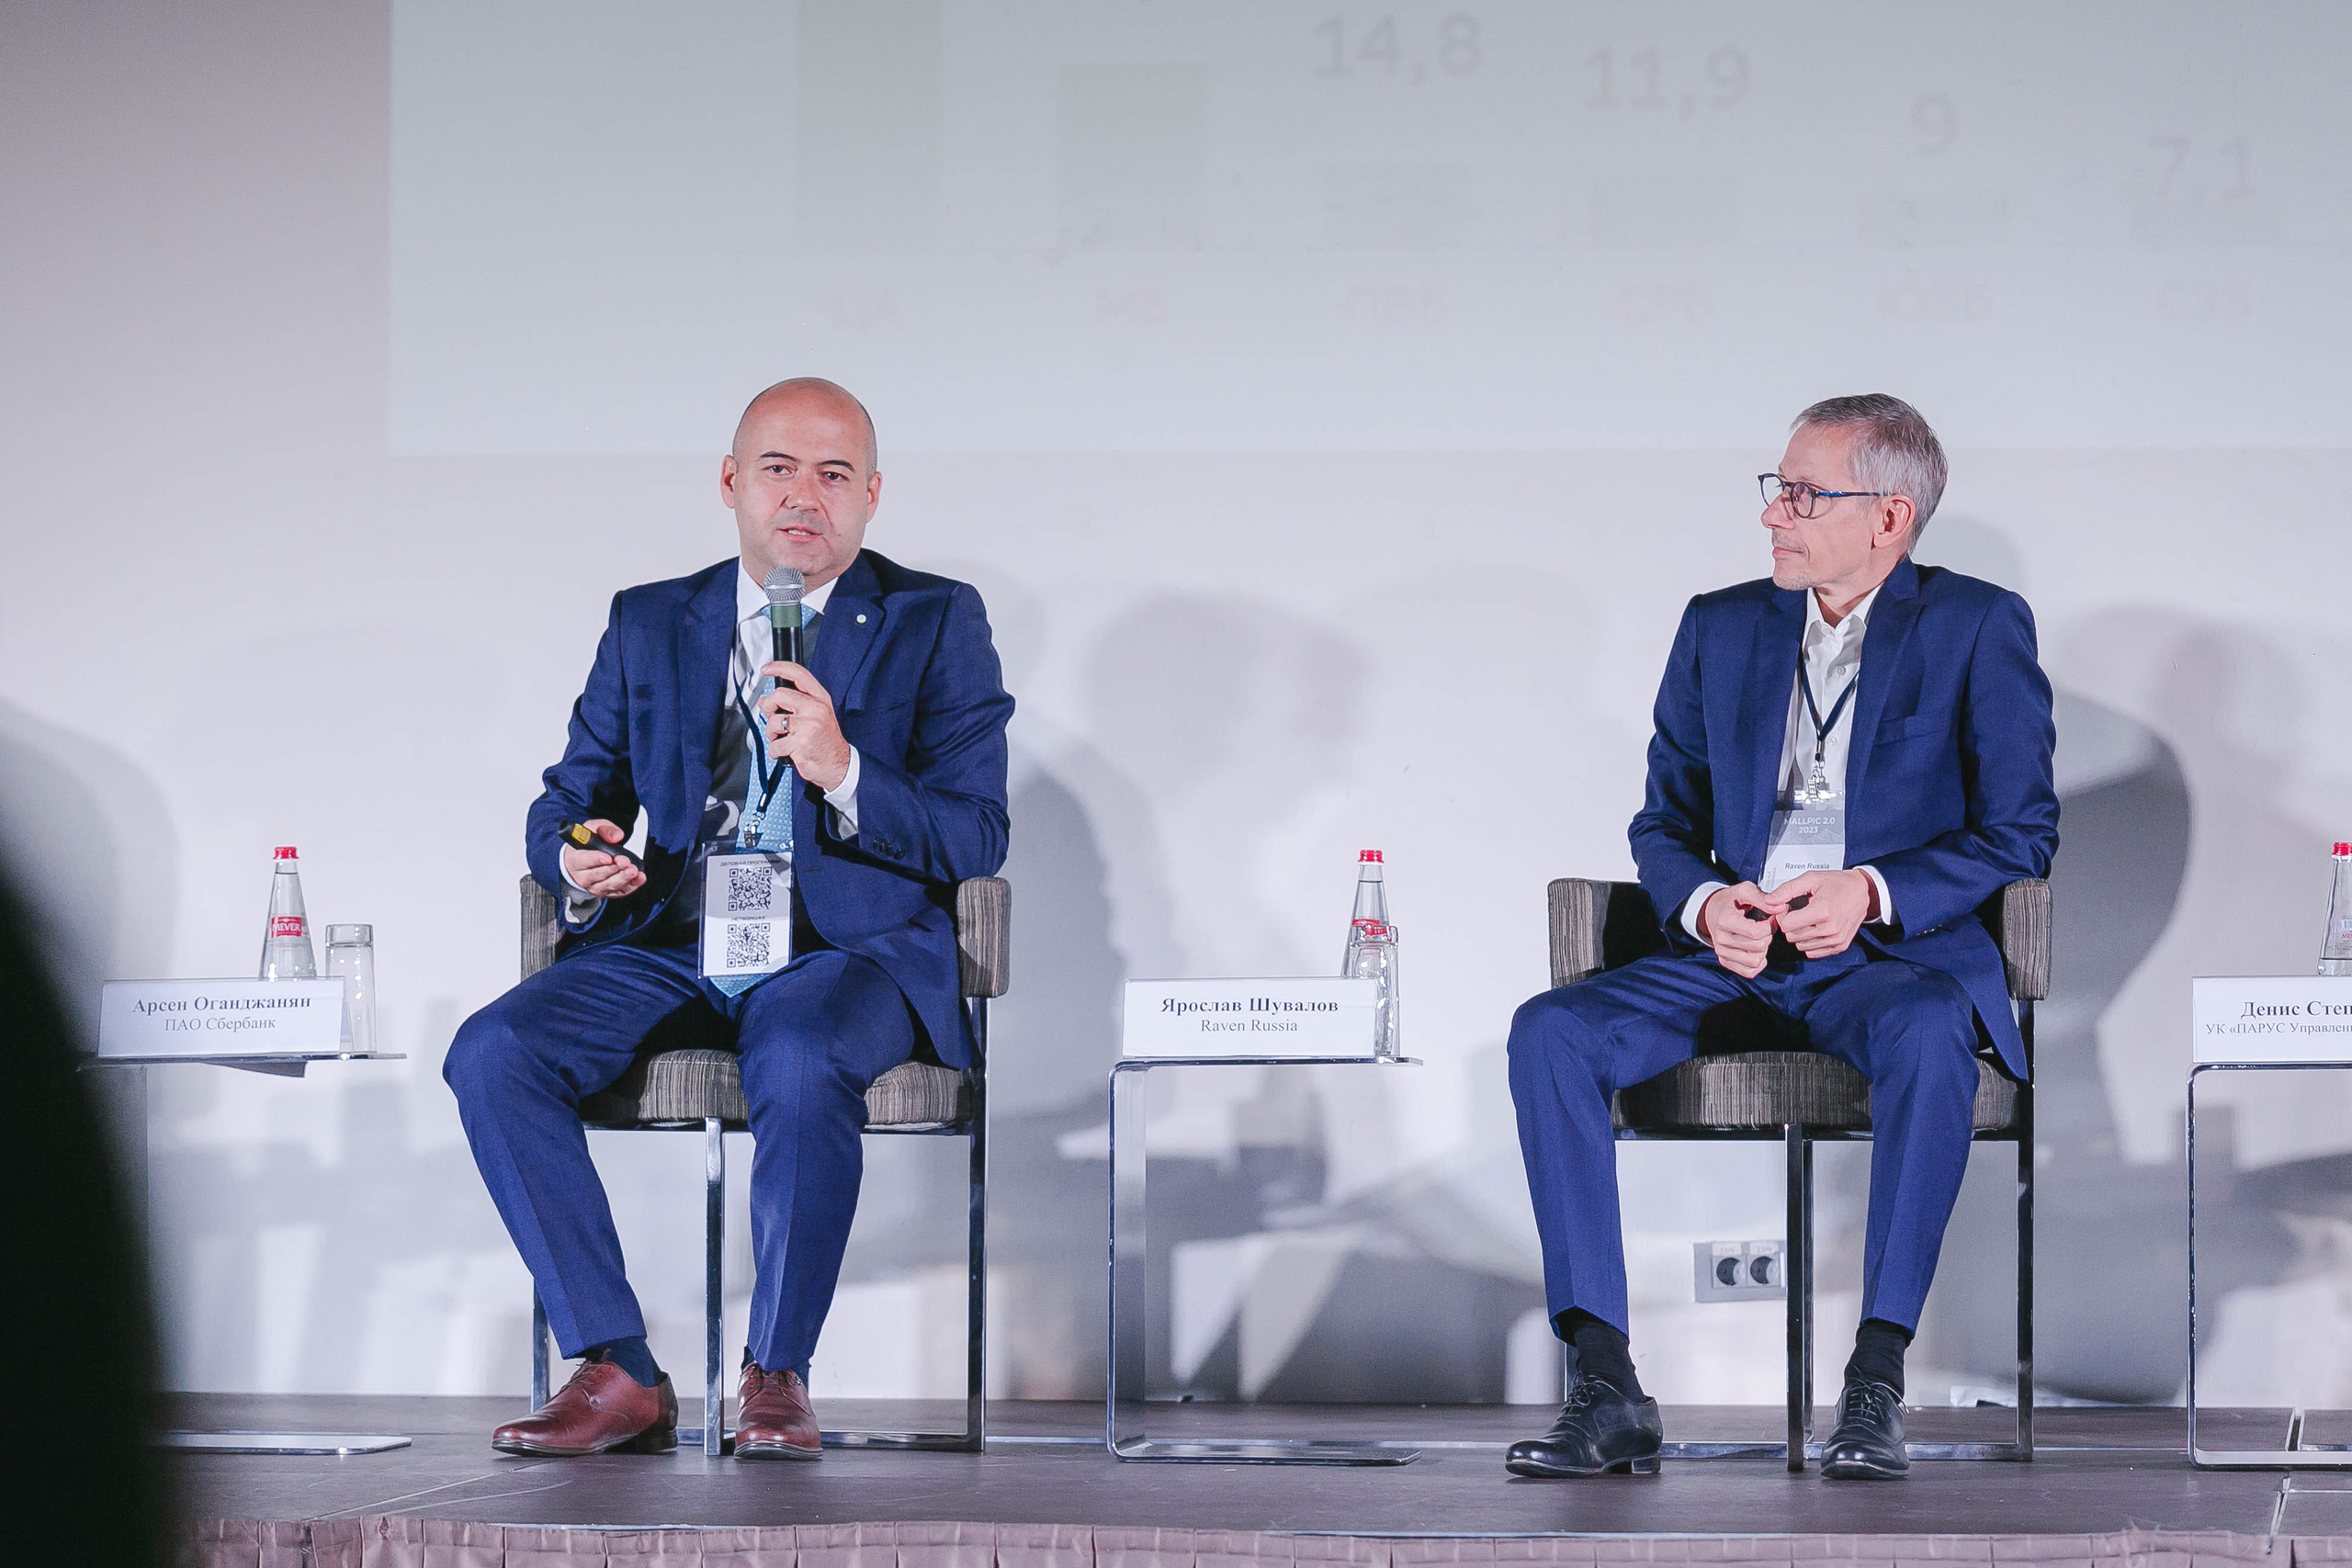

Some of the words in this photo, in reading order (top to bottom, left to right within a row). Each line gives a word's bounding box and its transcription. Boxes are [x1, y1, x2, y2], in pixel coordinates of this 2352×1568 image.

[1313, 12, 1484, 85] 14,8
[1583, 44, 1751, 121] 11,9
[1911, 93, 1960, 157] 9
[132, 998, 187, 1016] Арсен
[194, 996, 311, 1011] Оганджанян
[1160, 998, 1242, 1016] Ярослав
[1250, 998, 1339, 1016] Шувалов
[2240, 1001, 2301, 1020] Денис
[164, 1019, 201, 1031] ПАО
[206, 1016, 277, 1032] Сбербанк
[1201, 1020, 1245, 1032] Raven
[1251, 1019, 1297, 1032] Russia
[2206, 1023, 2226, 1034] УК
[2229, 1022, 2286, 1034] «ПАРУС
[2290, 1022, 2352, 1035] Управлен
